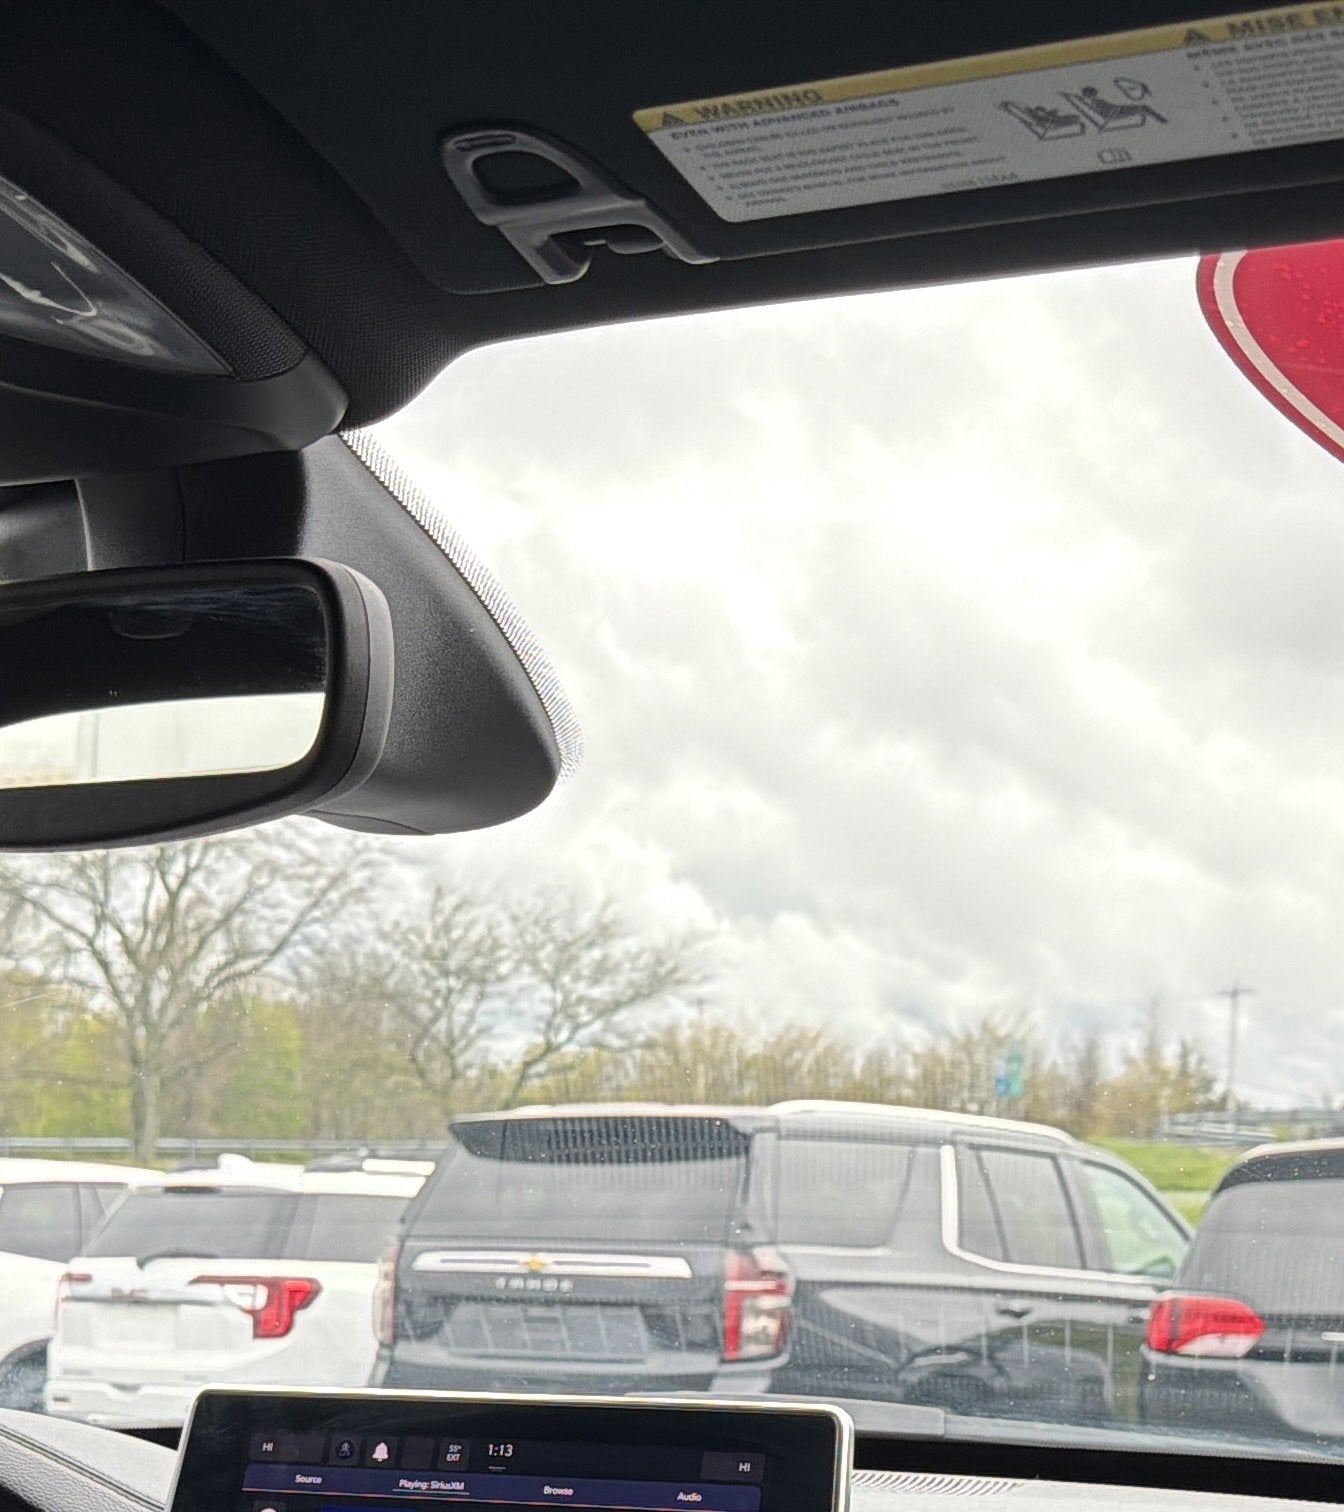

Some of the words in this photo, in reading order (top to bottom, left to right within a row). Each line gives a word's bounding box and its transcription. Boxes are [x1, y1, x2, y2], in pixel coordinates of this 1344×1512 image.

[692, 89, 824, 122] WARNING
[488, 1443, 513, 1457] 1:13
[294, 1473, 323, 1485] Source
[398, 1478, 429, 1491] Playing:
[543, 1485, 574, 1497] Browse
[677, 1490, 702, 1503] Audio
